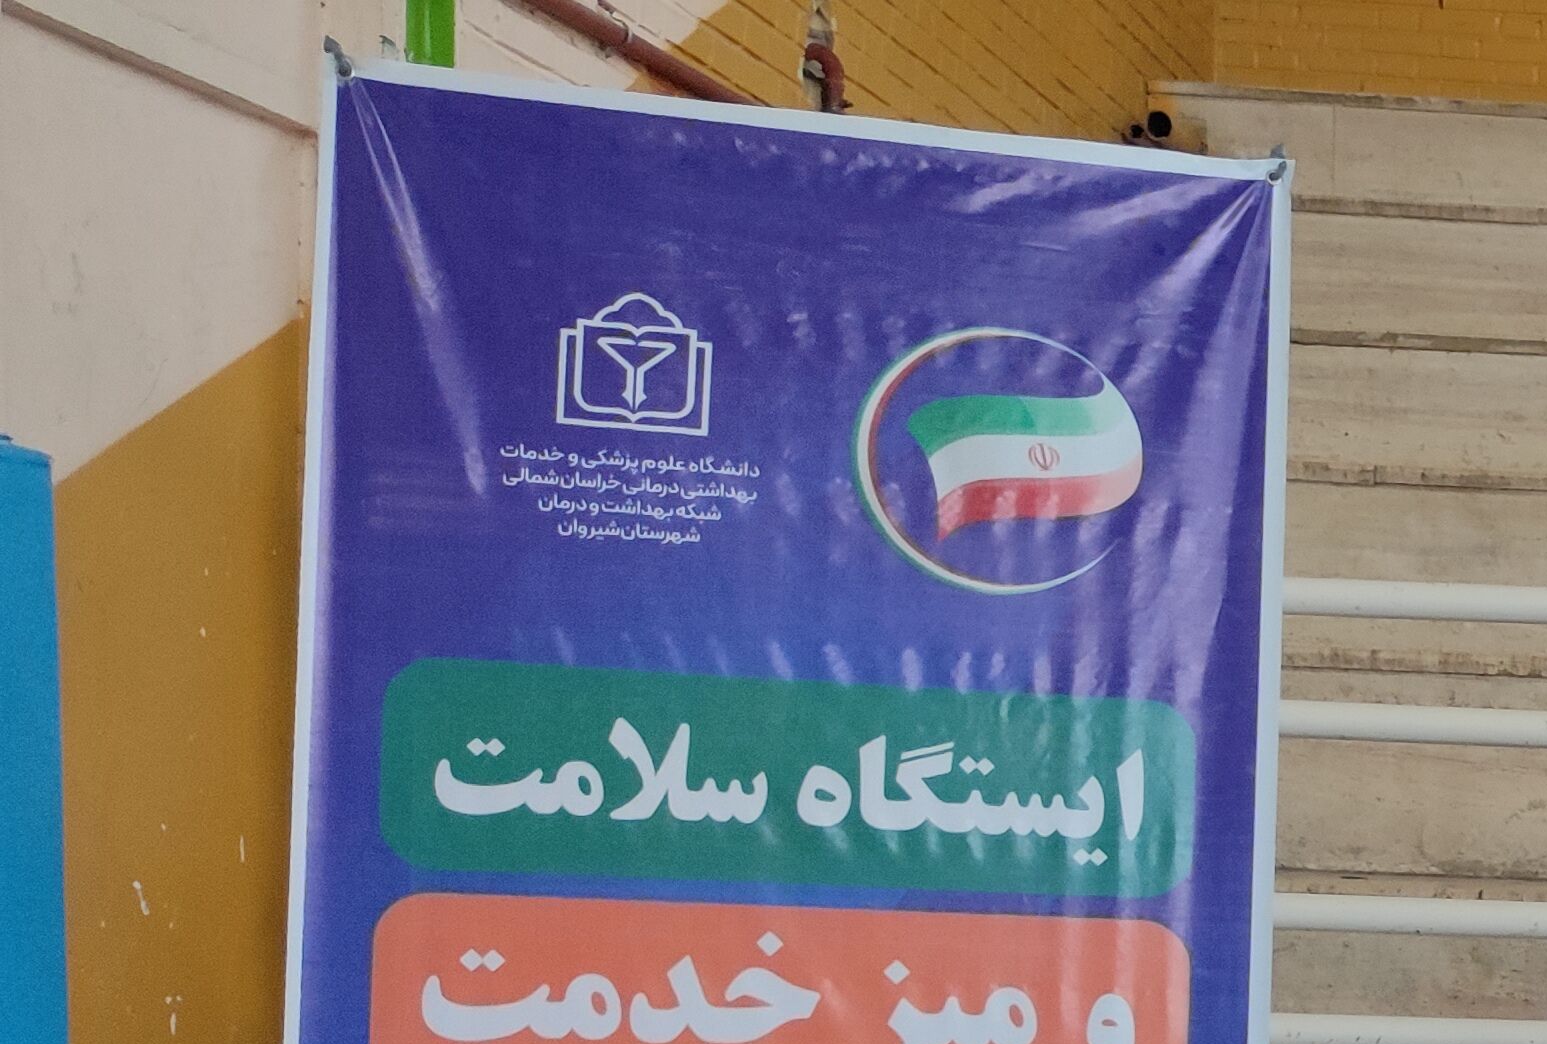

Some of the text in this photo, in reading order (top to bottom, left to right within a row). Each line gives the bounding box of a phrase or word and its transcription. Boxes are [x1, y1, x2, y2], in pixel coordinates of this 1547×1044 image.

[500, 443, 760, 478] دانشگاه علوم پزشکی و خدمات
[502, 466, 758, 505] بهداشتی درمانی خراسان شمالی
[538, 494, 722, 524] شبکه بهداشت و درمان
[557, 518, 701, 545] شهرستان شیروان
[434, 716, 1145, 866] ایستگاه سلامت
